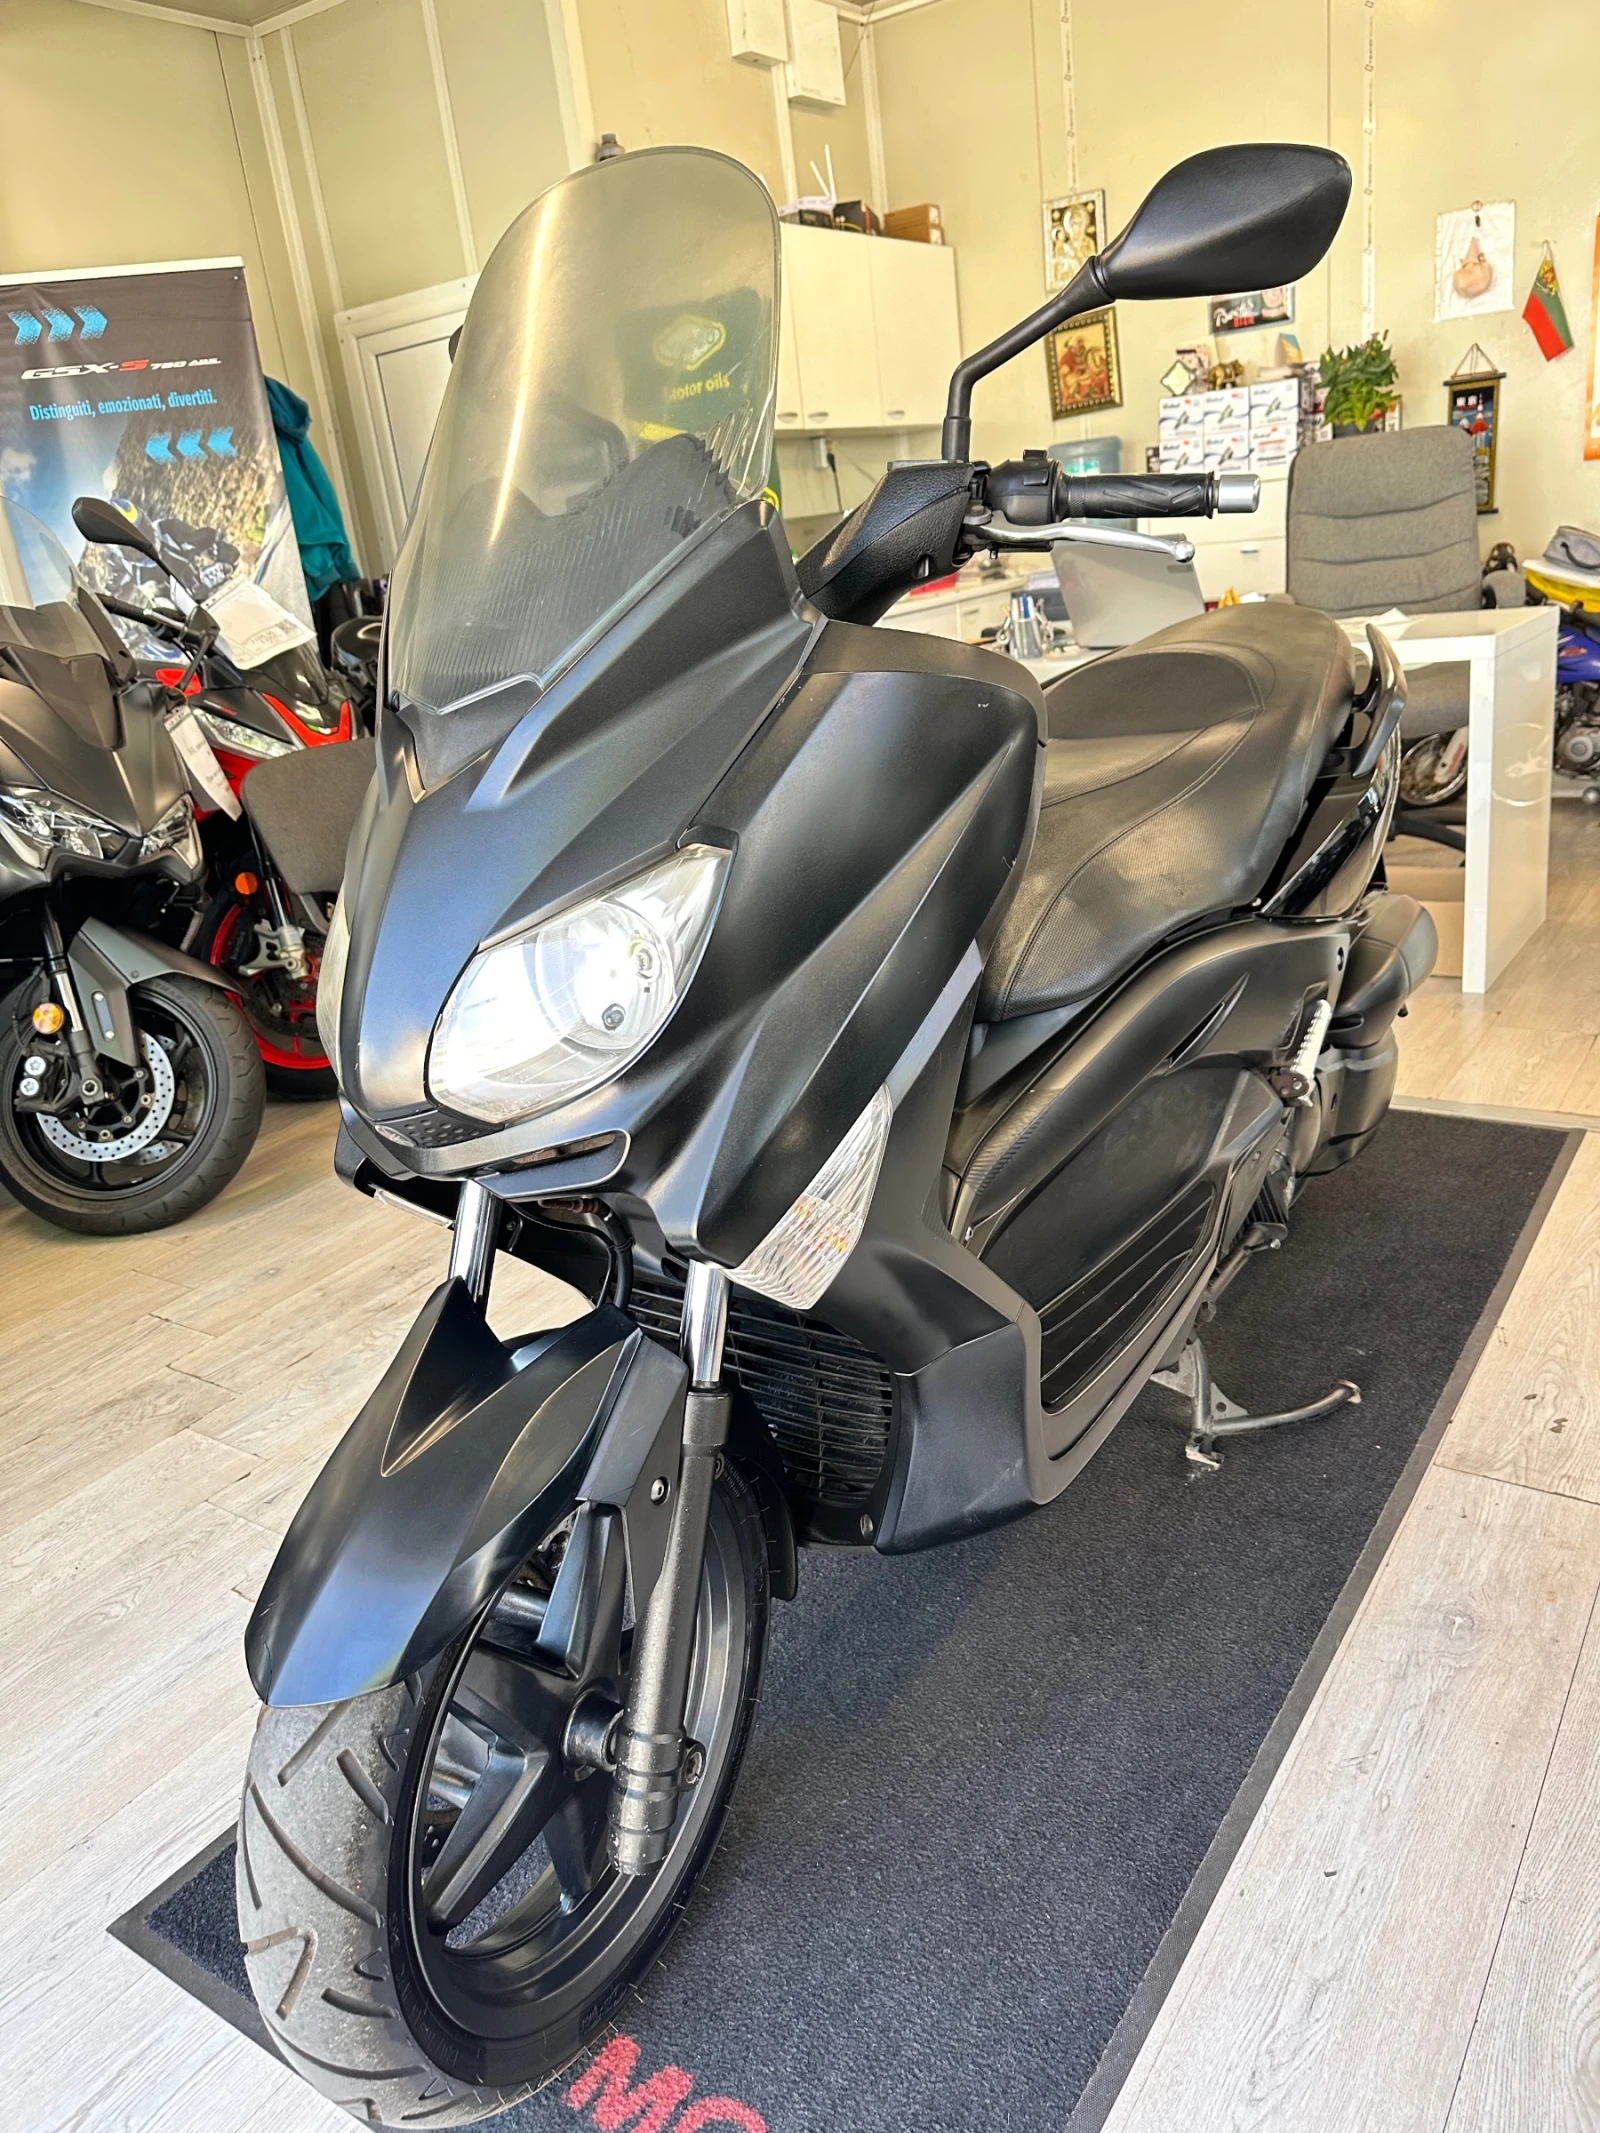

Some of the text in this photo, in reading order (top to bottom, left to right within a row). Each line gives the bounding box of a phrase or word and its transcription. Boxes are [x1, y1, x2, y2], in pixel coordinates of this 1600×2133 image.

[21, 359, 150, 380] GSX-S
[705, 371, 730, 392] oils
[29, 388, 218, 420] Distinguiti, emozionati, divertiti.
